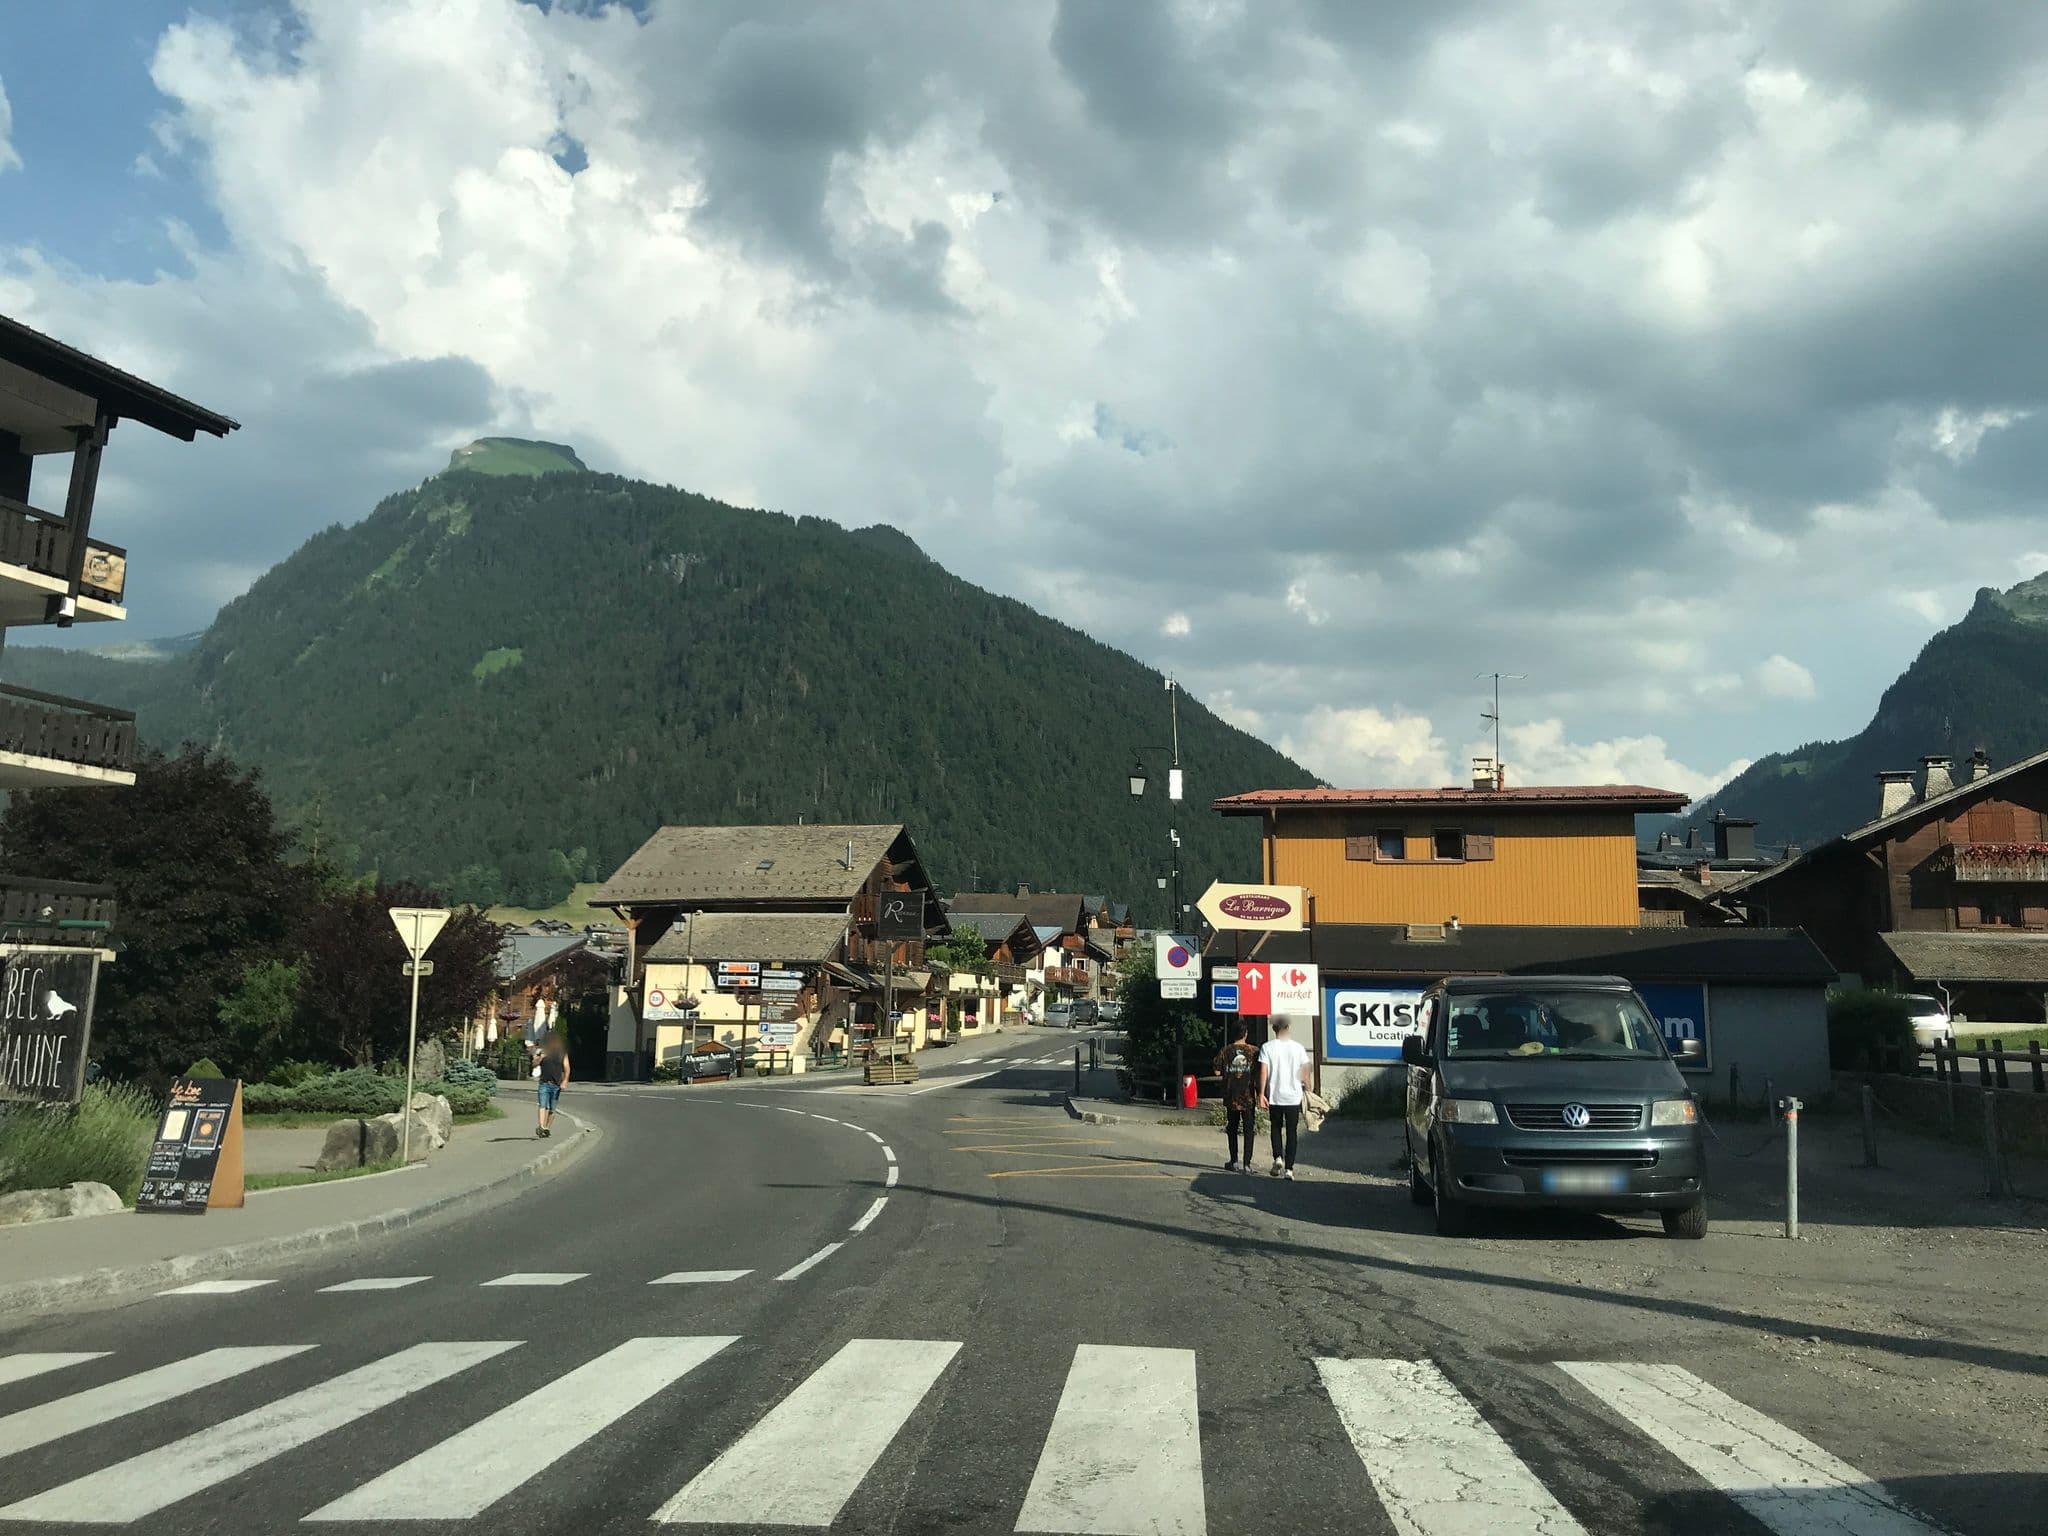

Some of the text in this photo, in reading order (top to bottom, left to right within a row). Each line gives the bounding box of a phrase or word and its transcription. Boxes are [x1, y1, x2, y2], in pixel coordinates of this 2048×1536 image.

[1225, 899, 1286, 917] La Barrique
[6, 967, 44, 1020] BEC
[1276, 989, 1312, 1000] market
[1340, 1003, 1420, 1027] SKIS
[0, 1033, 68, 1088] JAUNE
